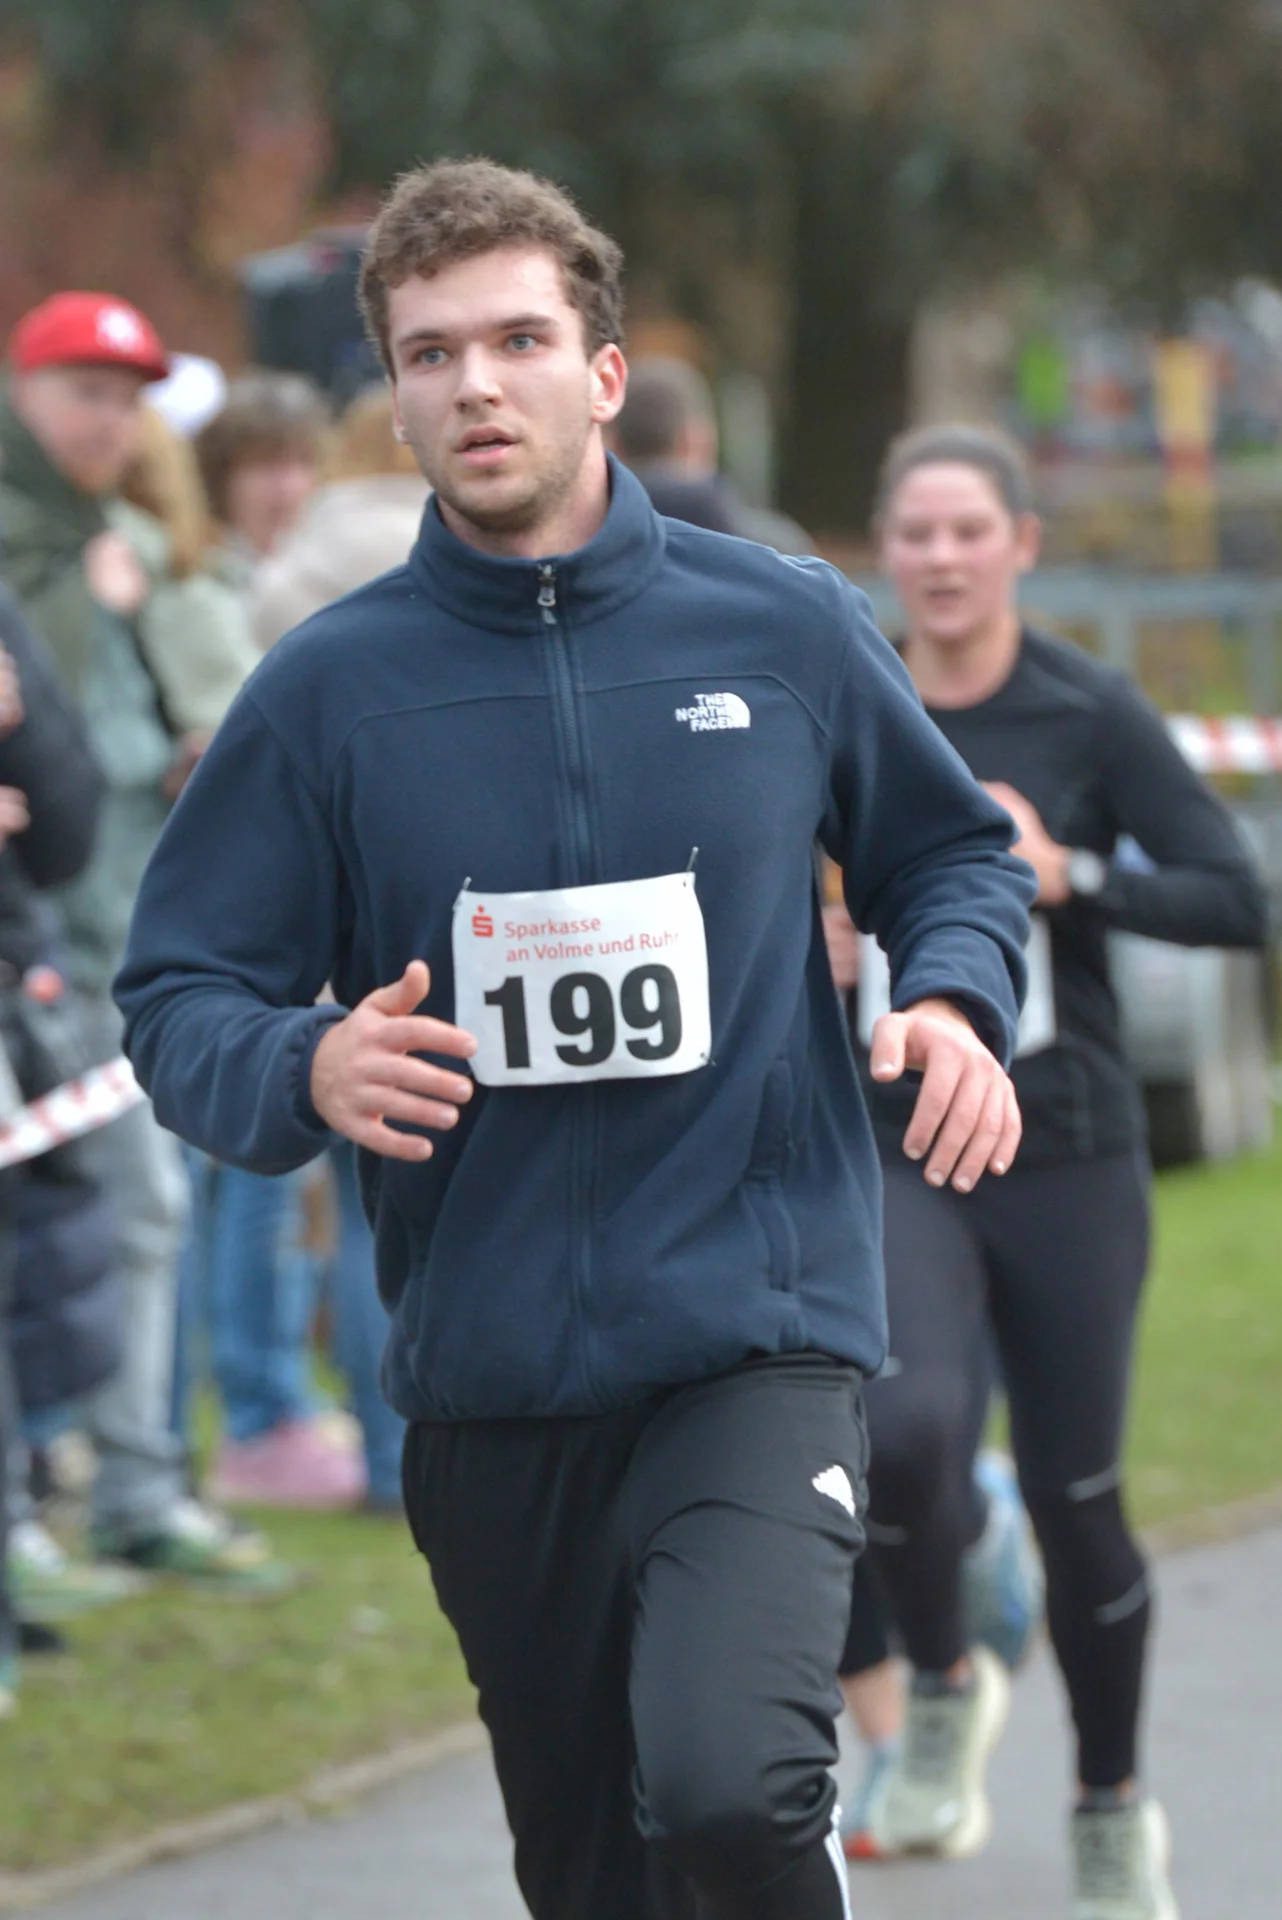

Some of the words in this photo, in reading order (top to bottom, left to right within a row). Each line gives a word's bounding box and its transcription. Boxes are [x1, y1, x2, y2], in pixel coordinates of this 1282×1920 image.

[694, 693, 724, 706] THE
[675, 706, 726, 722] NORTH
[690, 717, 729, 732] FACE
[504, 917, 601, 940] Sparkasse
[506, 949, 530, 962] an
[534, 942, 593, 960] Volme
[599, 933, 635, 955] und
[484, 963, 682, 1069] 199
